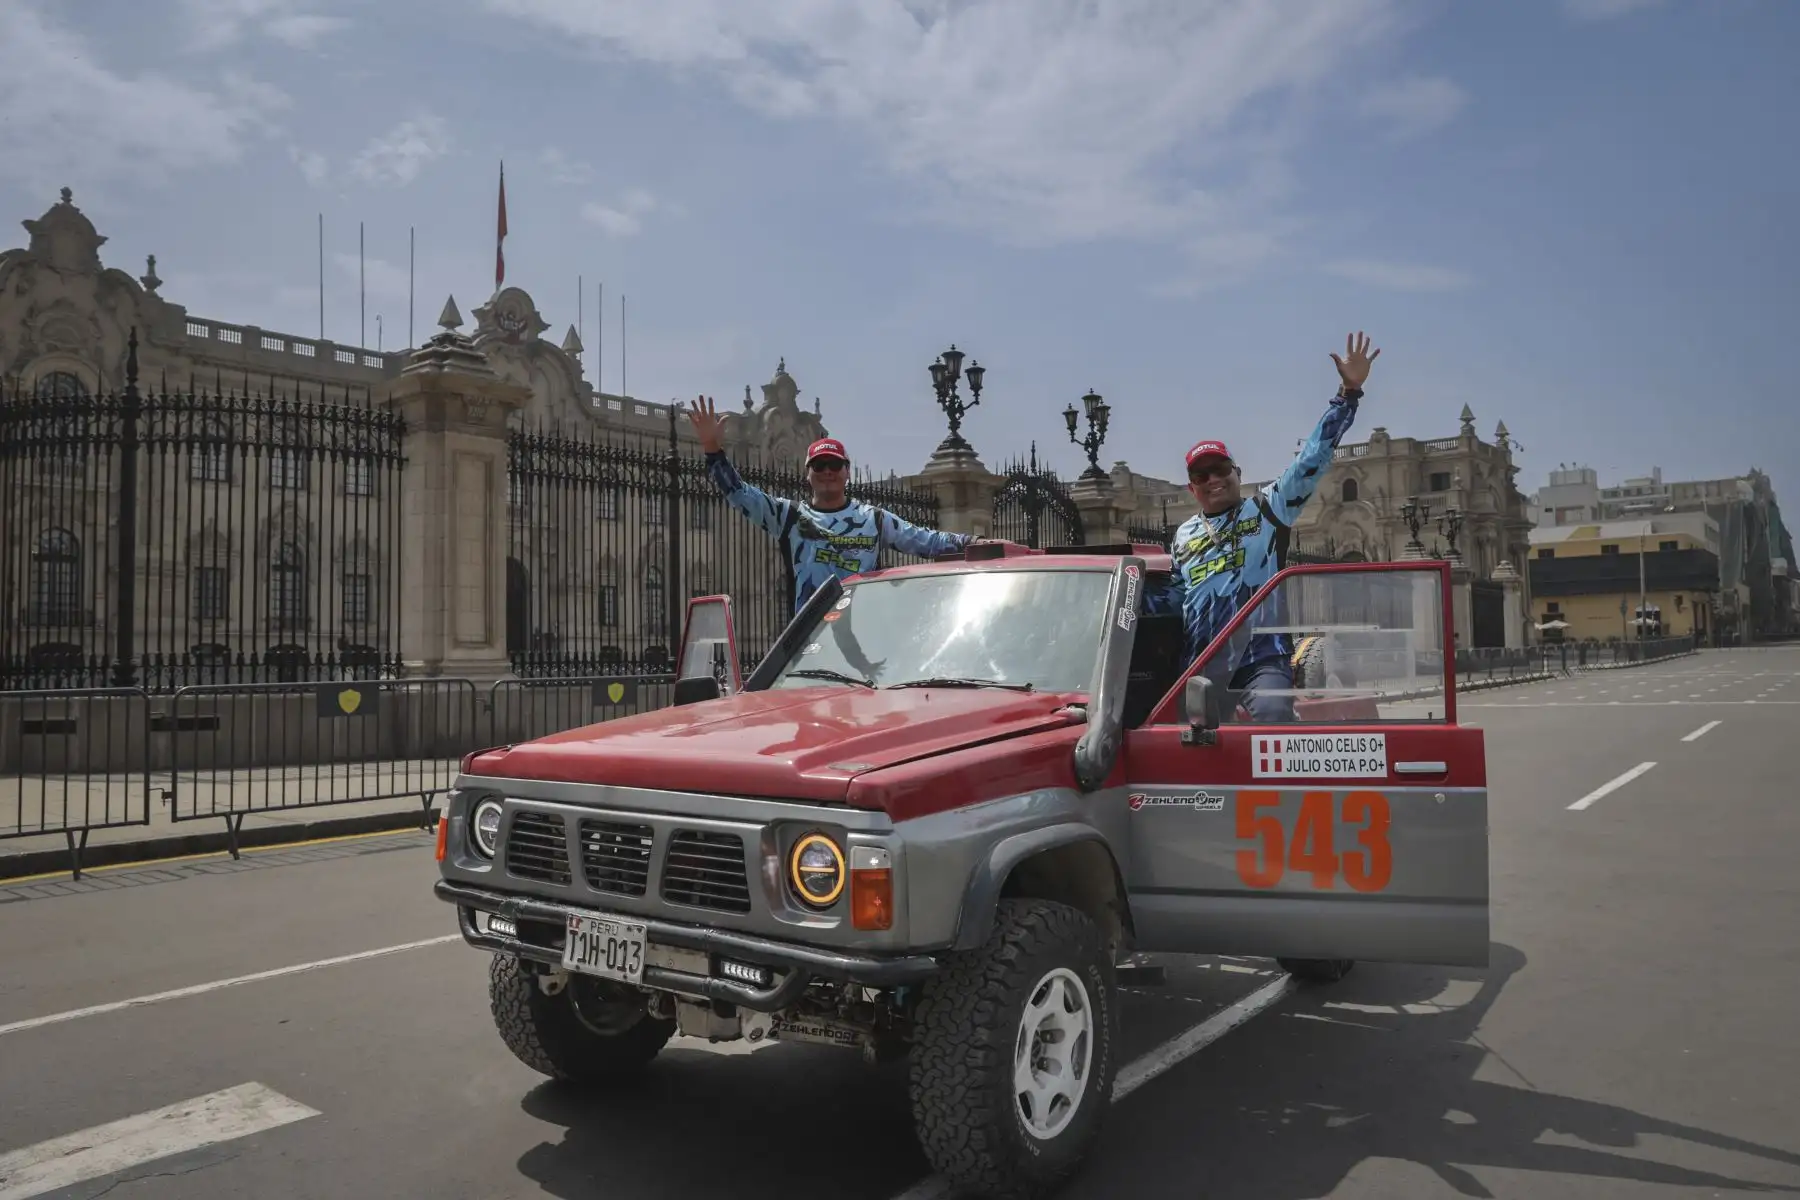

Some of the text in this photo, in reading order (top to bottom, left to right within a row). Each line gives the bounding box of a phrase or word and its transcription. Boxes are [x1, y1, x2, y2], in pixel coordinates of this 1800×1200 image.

[814, 443, 838, 452] MOTUL
[1191, 443, 1220, 456] MOTUL
[1286, 738, 1384, 753] ANTONIO CELIS O+
[1286, 759, 1321, 773] JULIO
[1324, 759, 1356, 773] SOTA
[1145, 793, 1223, 805] ZEHLENDORF
[1235, 790, 1393, 893] 543
[590, 921, 619, 936] PERU
[569, 930, 642, 975] T1H-013
